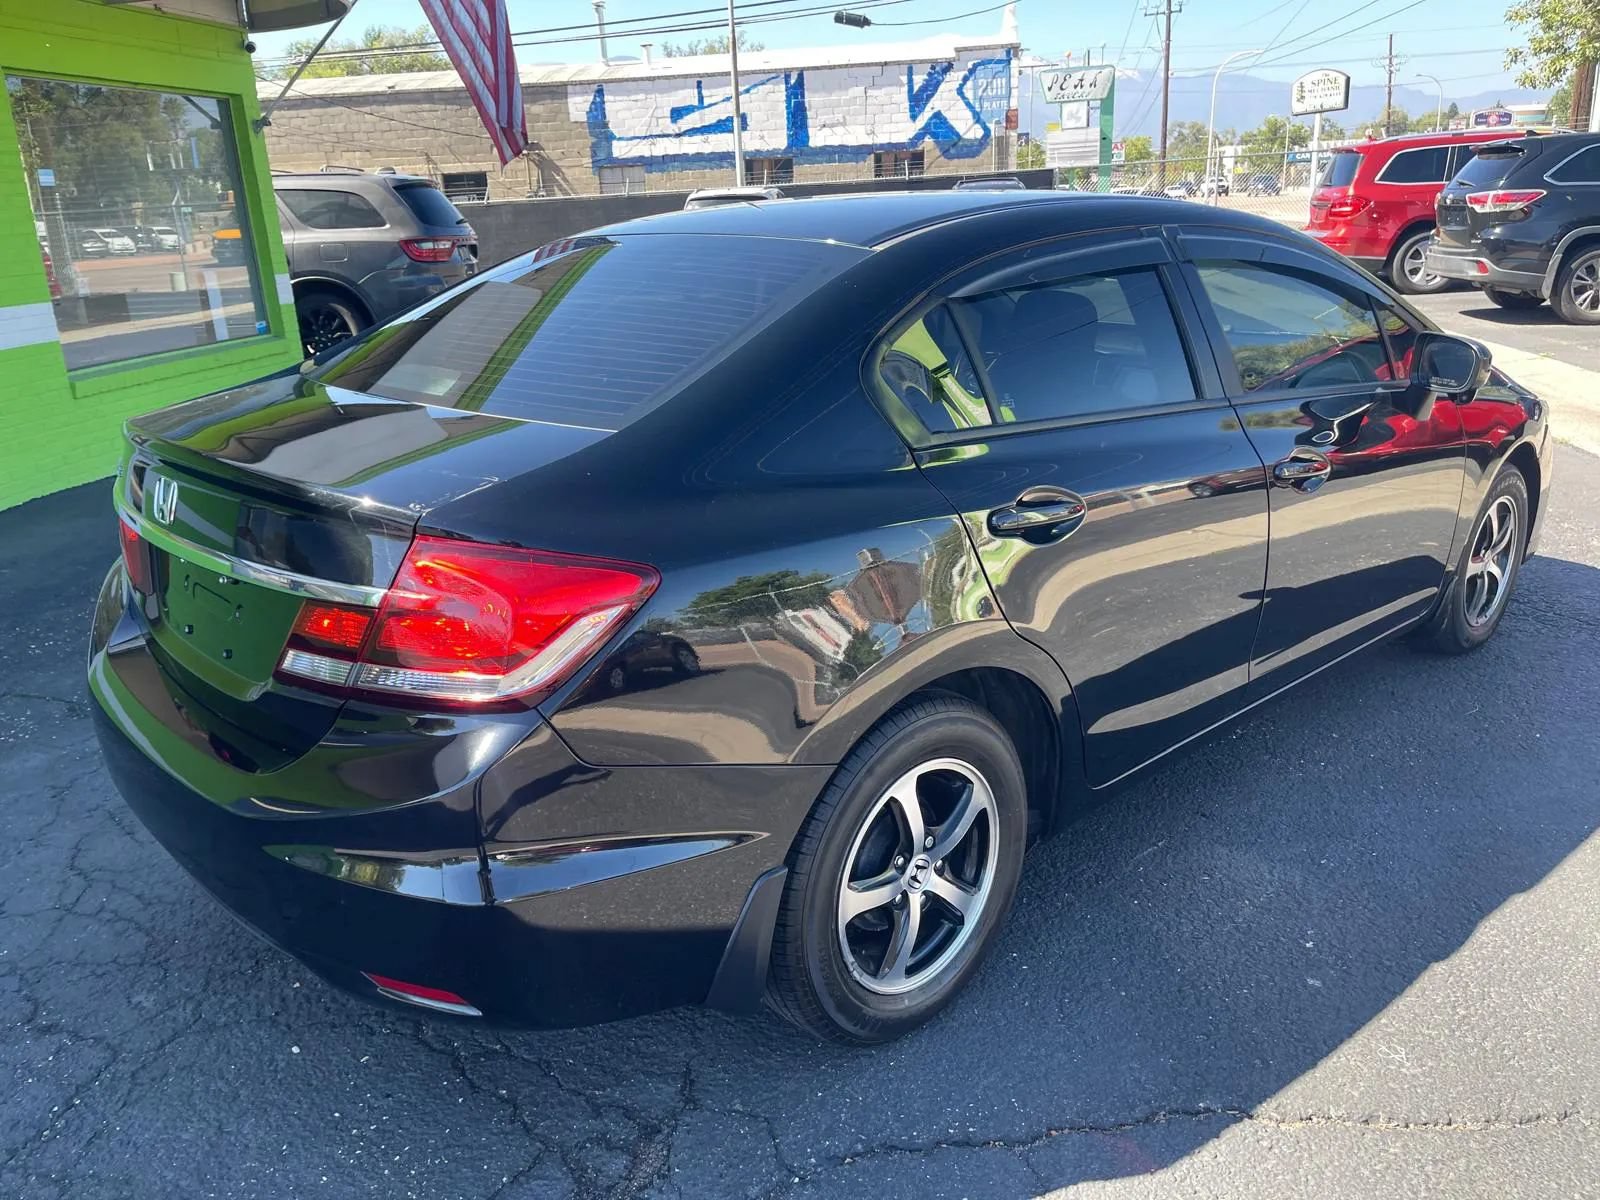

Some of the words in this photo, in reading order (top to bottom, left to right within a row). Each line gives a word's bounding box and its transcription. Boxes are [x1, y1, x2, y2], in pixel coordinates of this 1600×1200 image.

[978, 78, 1006, 96] 2011
[1311, 77, 1340, 87] SPINE
[984, 101, 1009, 110] PLATTE
